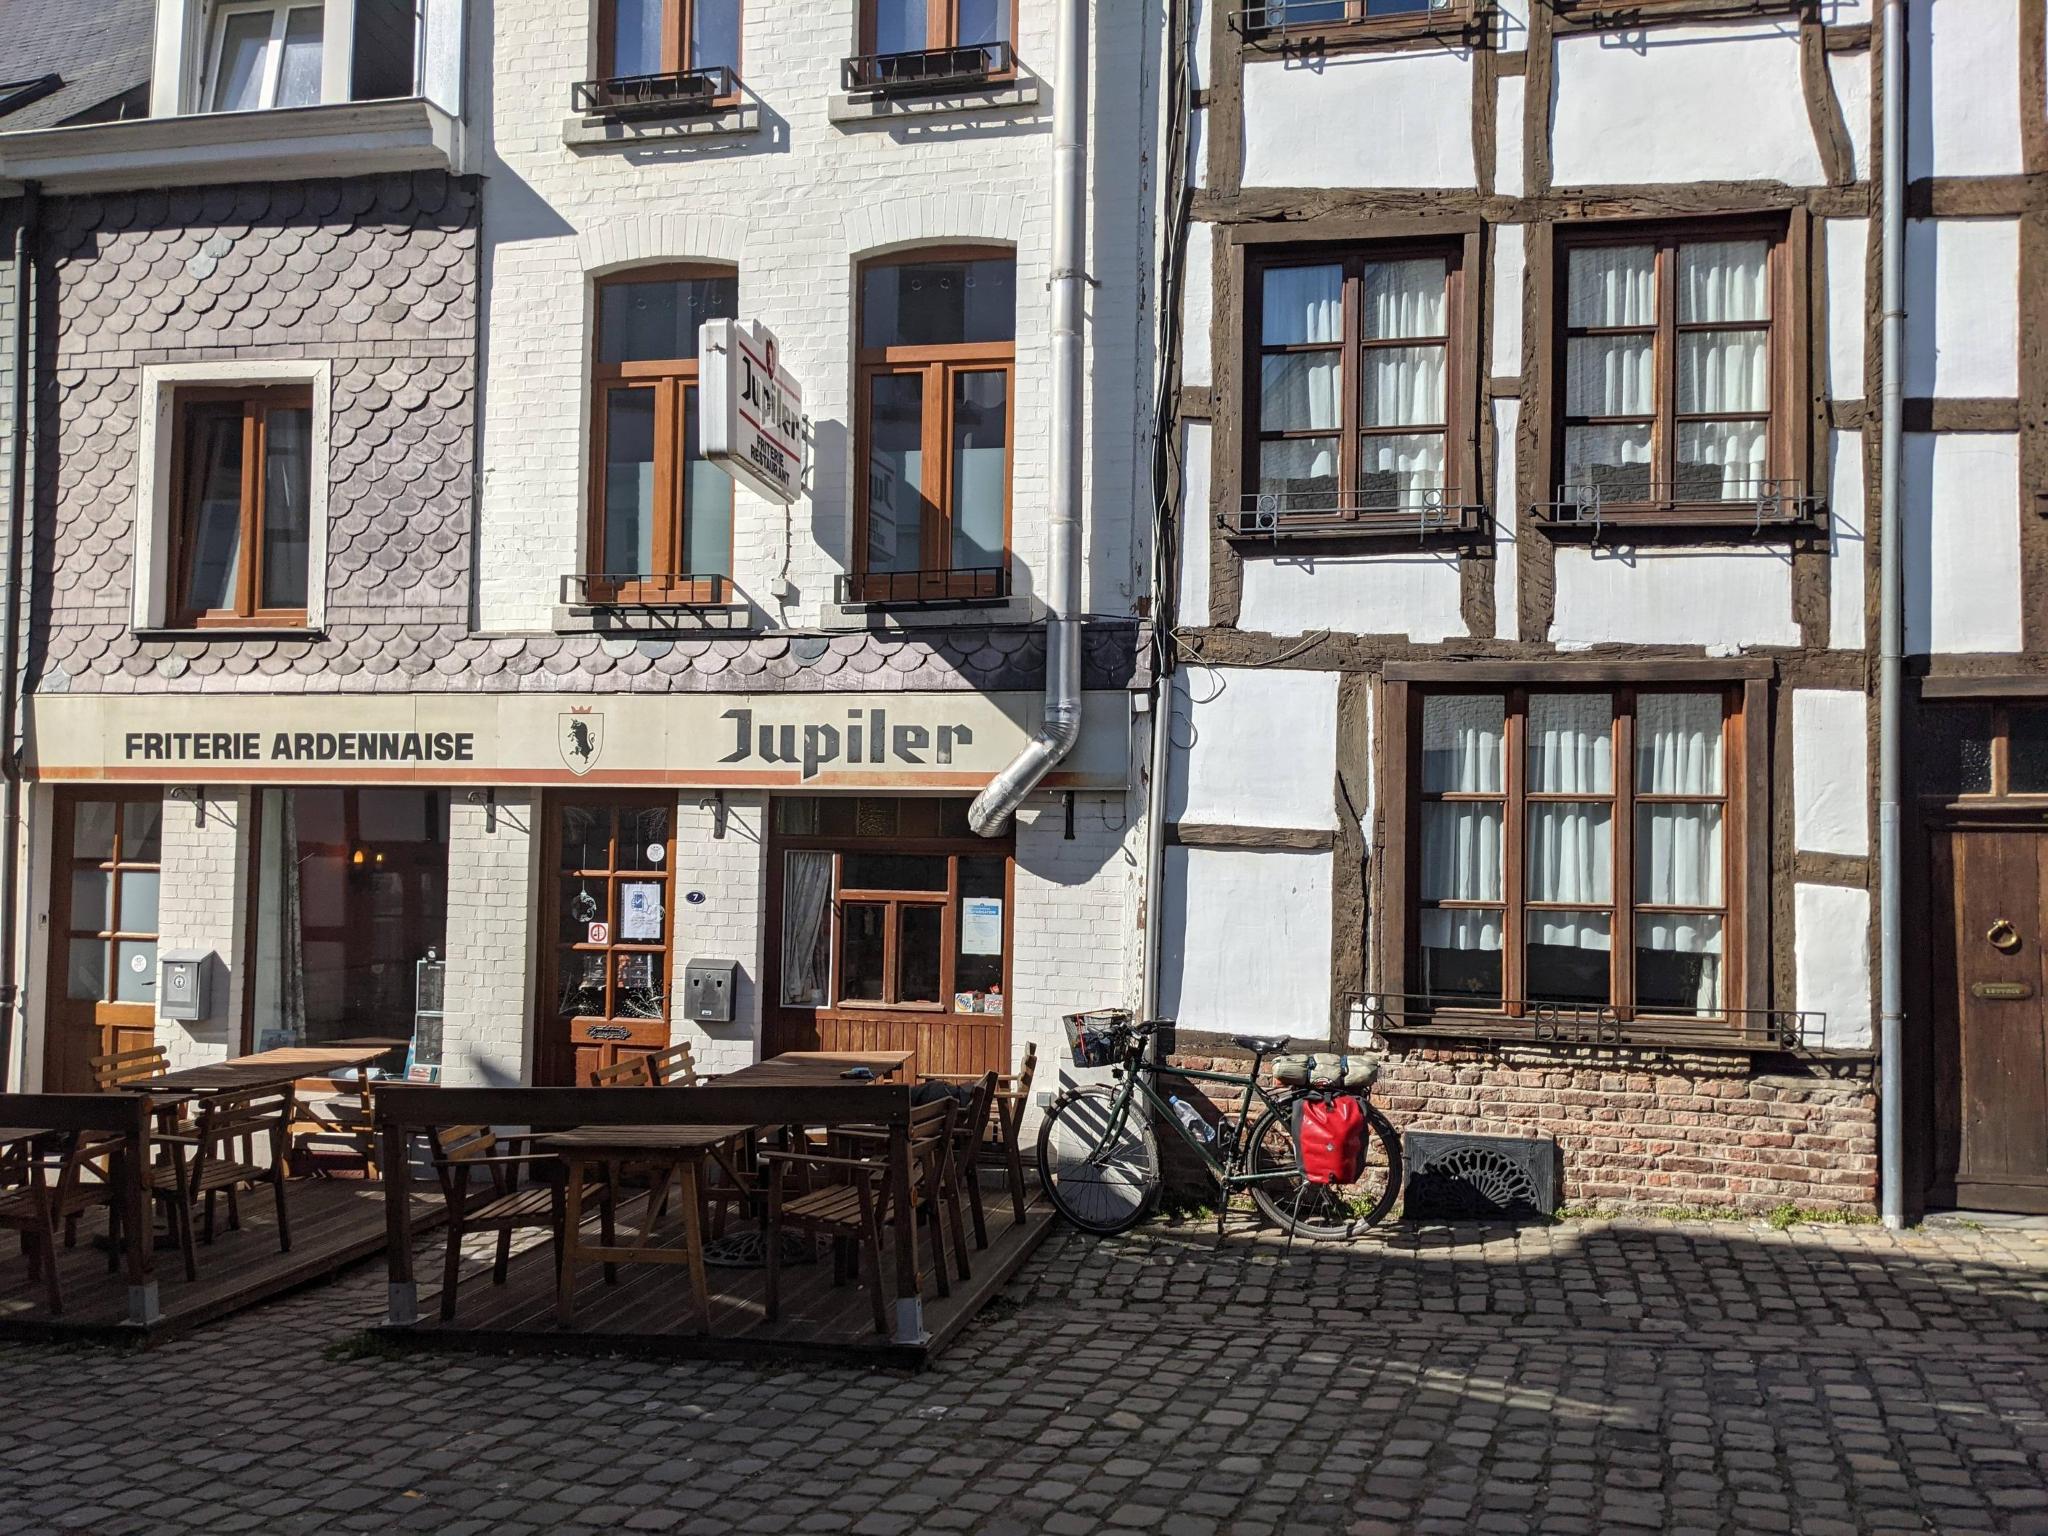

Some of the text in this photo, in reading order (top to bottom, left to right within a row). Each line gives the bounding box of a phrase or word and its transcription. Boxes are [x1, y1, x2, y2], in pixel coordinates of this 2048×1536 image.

[741, 355, 800, 441] Jupiler
[750, 443, 790, 486] RESTAURANT
[756, 433, 784, 468] FRITERIE
[125, 732, 474, 761] FRITERIE ARDENNAISE
[717, 708, 973, 780] Jupiler
